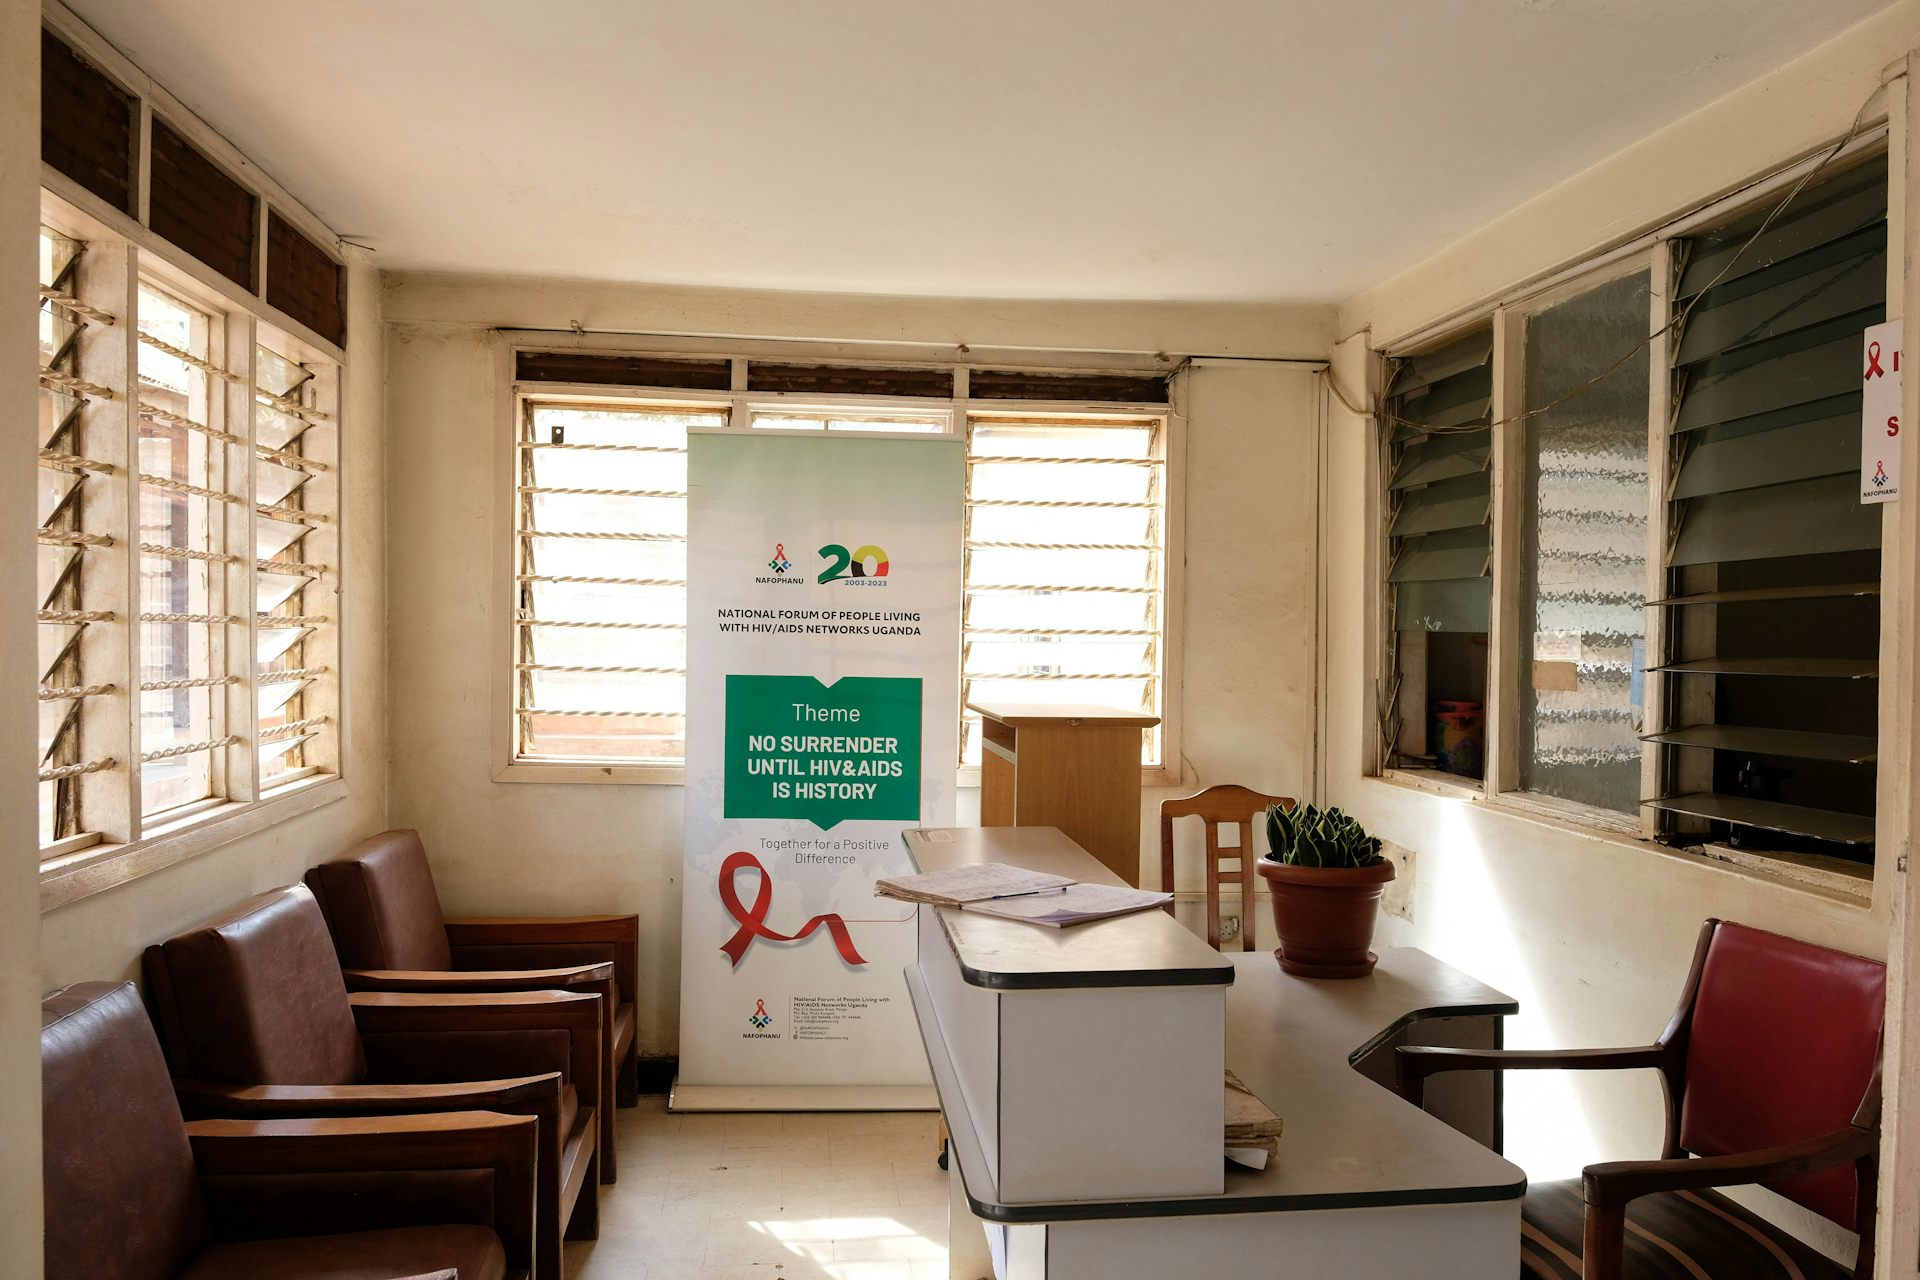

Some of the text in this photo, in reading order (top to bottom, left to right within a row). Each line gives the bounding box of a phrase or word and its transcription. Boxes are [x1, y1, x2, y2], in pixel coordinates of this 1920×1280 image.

[1863, 487, 1898, 498] NAFOPHANU
[818, 544, 889, 585] 20
[755, 576, 804, 585] NAFOPHANU
[844, 579, 888, 588] 2003-2023
[718, 608, 921, 622] NATIONAL FORUM OF PEOPLE LIVING
[719, 623, 921, 636] WITH HIV/AIDS NETWORKS UGANDA
[792, 703, 861, 723] Theme
[748, 735, 898, 754] NO SURRENDER
[747, 758, 903, 777] UNTIL HIV&AIDS
[772, 782, 878, 800] IS HISTORY
[760, 837, 889, 851] Together for a Positive
[795, 852, 856, 865] Difference
[842, 996, 861, 1004] People
